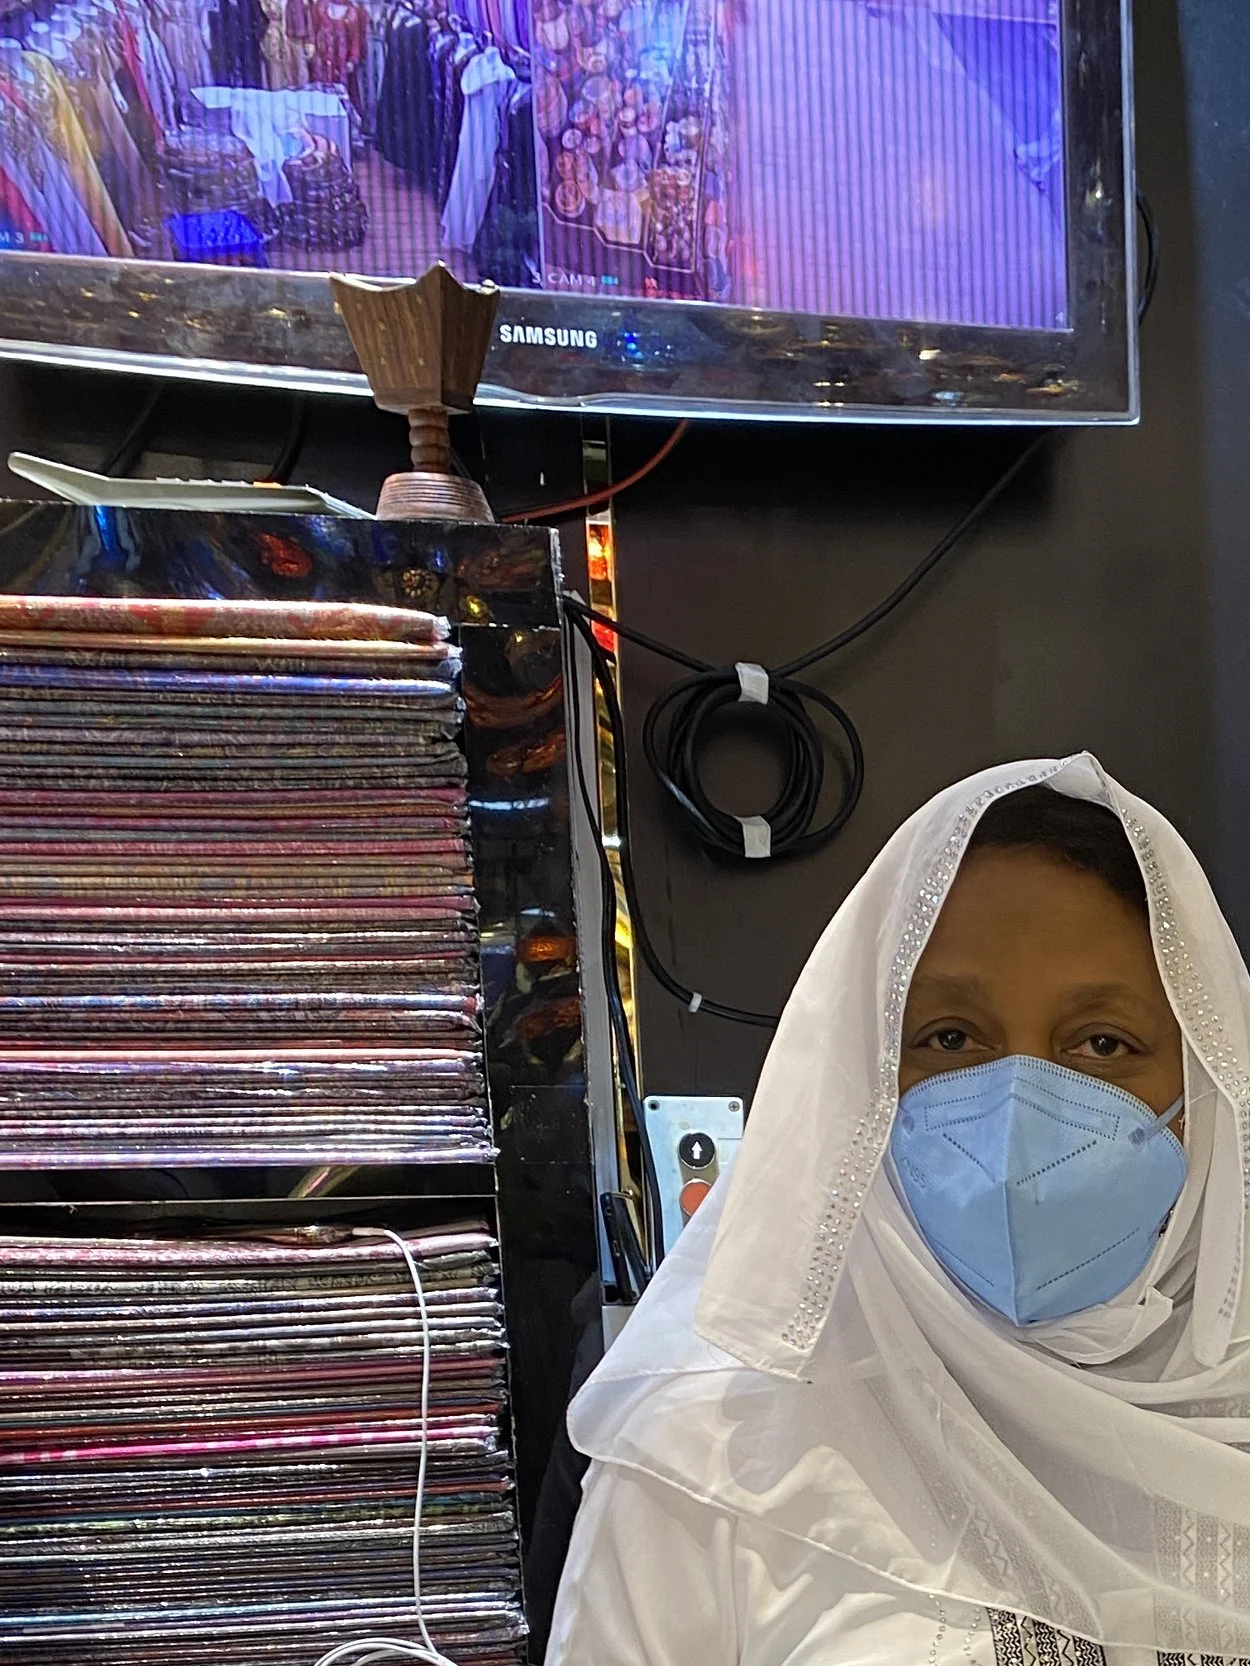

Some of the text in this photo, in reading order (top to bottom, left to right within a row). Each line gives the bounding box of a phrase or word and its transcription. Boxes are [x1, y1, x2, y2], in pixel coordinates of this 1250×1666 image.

[14, 231, 25, 244] 3
[547, 271, 583, 286] CAM
[499, 324, 599, 349] SAMSUNG
